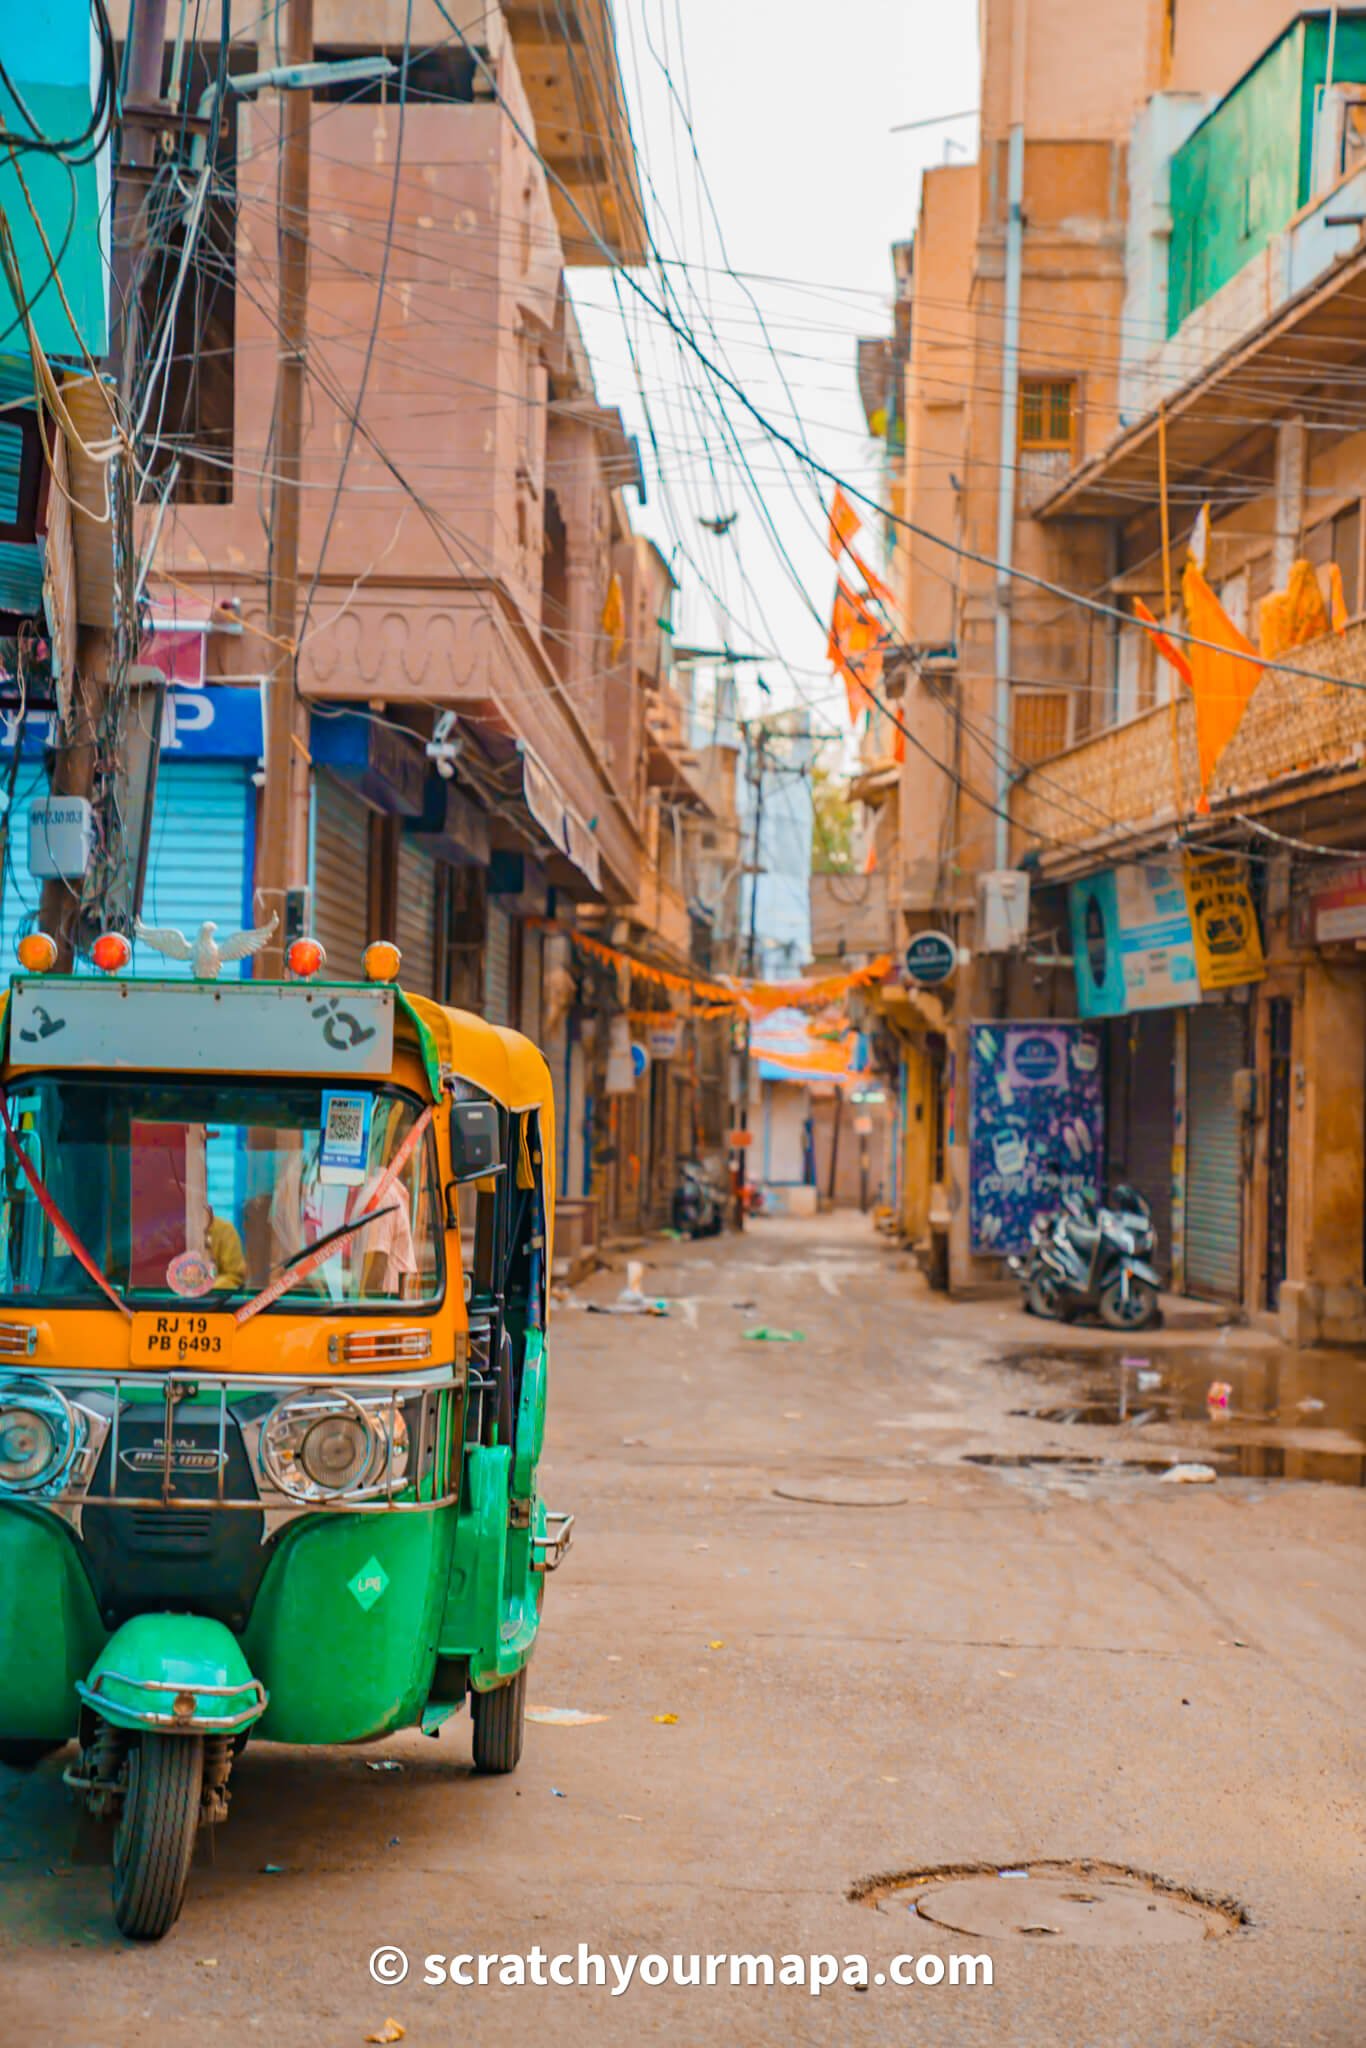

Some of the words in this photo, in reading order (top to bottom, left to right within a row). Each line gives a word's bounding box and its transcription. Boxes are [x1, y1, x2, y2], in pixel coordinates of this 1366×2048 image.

[157, 1317, 179, 1333] RJ
[187, 1317, 207, 1334] 19
[148, 1335, 171, 1351] PB
[178, 1335, 222, 1353] 6493
